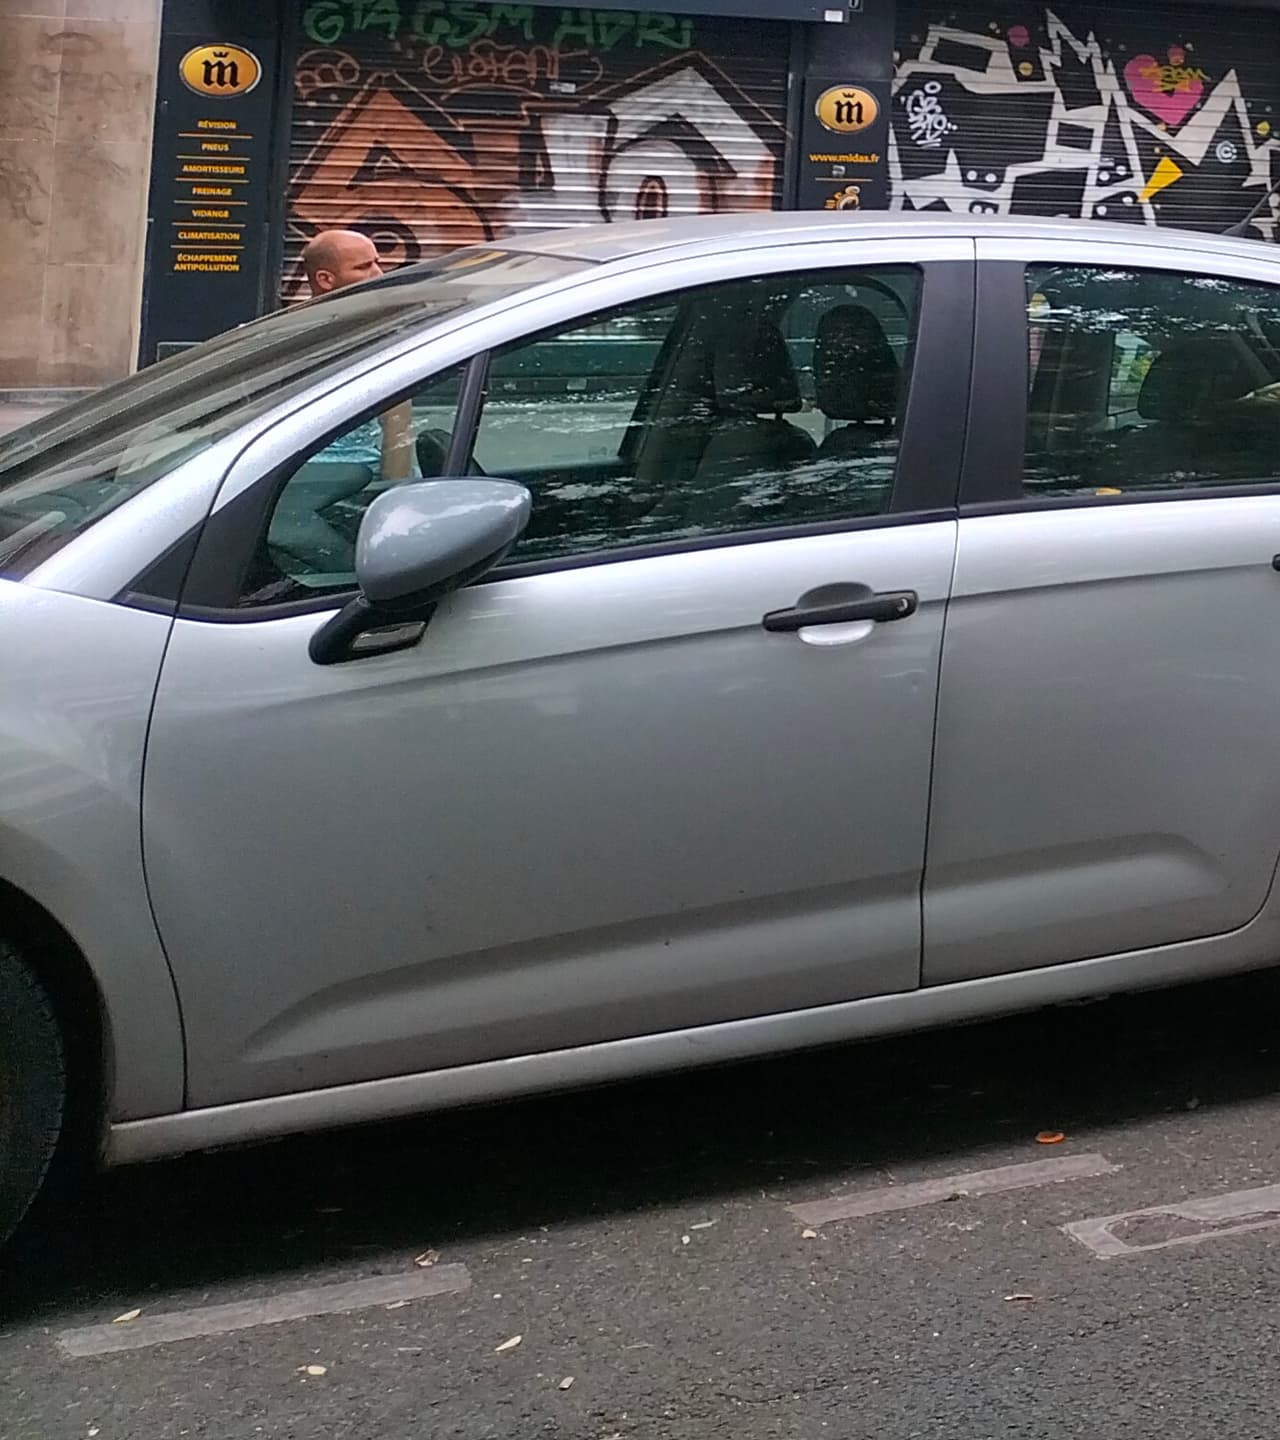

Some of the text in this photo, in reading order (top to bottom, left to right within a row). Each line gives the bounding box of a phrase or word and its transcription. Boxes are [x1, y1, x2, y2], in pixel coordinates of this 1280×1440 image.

[198, 120, 236, 129] RÉVISION
[202, 143, 229, 152] PNEUS
[809, 153, 880, 163] www.midas.fr
[182, 164, 245, 174] AMORTISSEURS
[192, 187, 232, 196] FREINAGE
[192, 210, 229, 218] VIDANGE
[178, 231, 240, 241] CLIMATISATION
[177, 252, 238, 262] ÉCHAPPEMENT
[174, 264, 240, 272] ANTIPOLLUTION
